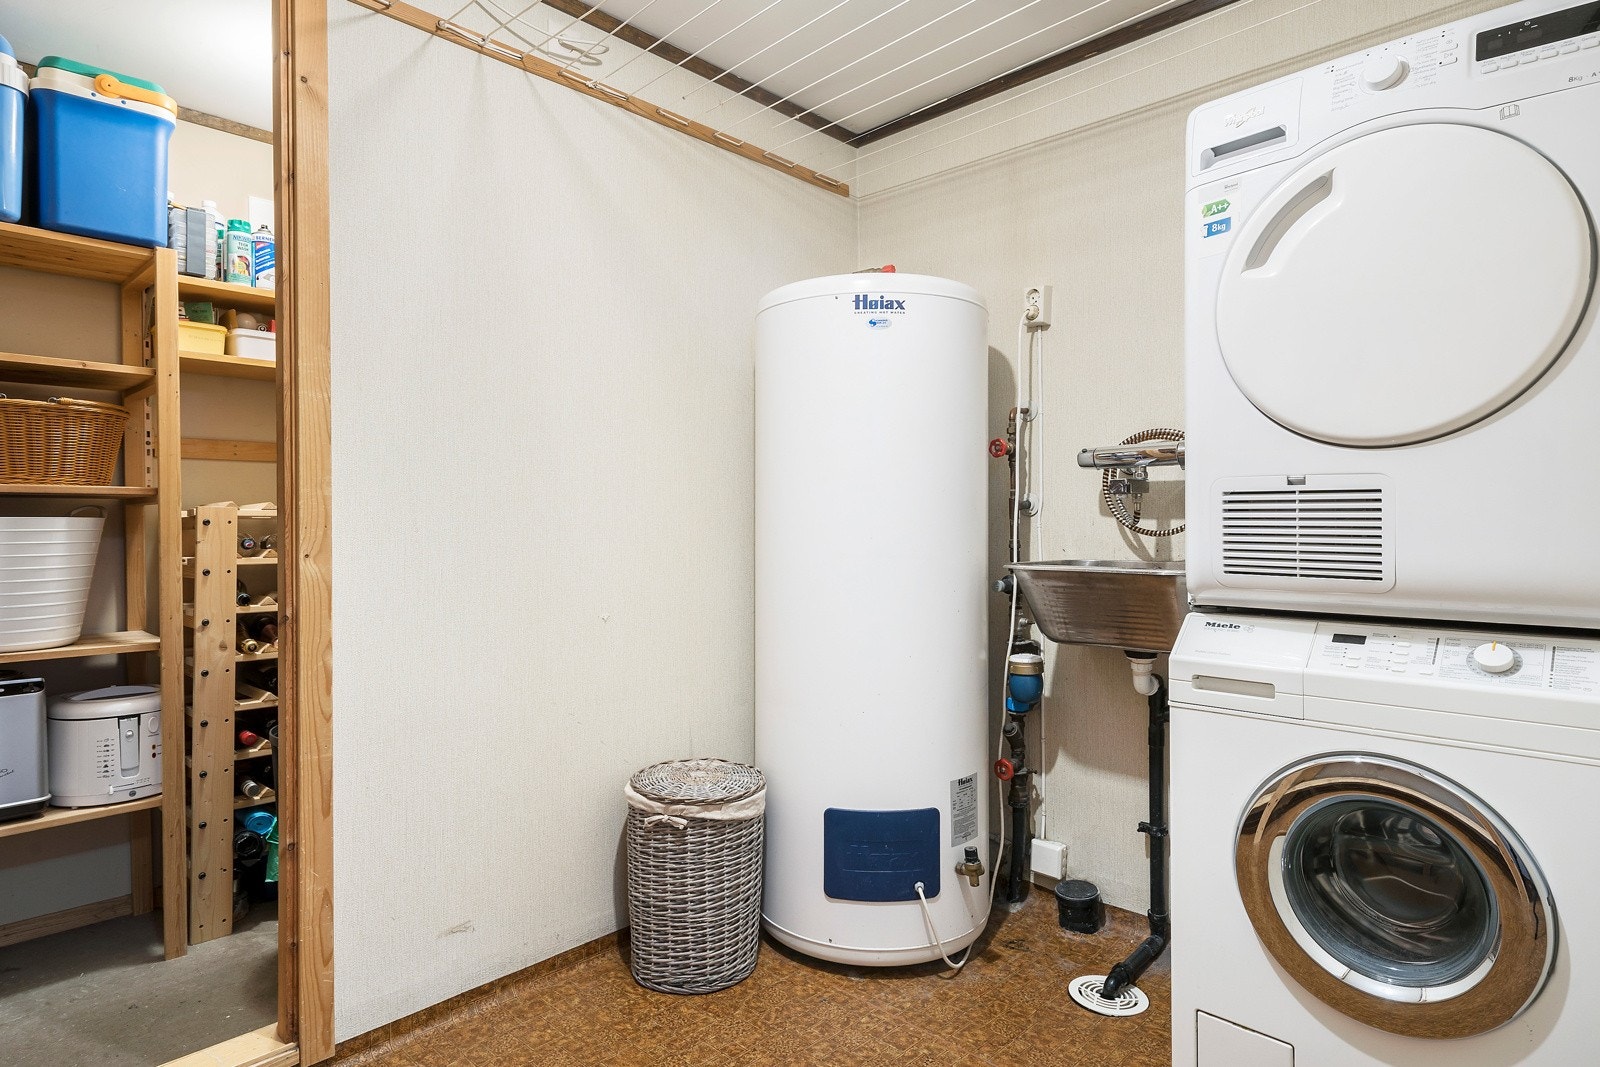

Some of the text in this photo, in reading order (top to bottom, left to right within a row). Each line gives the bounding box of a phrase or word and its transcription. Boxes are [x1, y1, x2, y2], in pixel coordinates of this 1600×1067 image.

[1211, 222, 1226, 233] 8kg
[852, 294, 905, 310] Høiax
[1205, 621, 1241, 630] Miele
